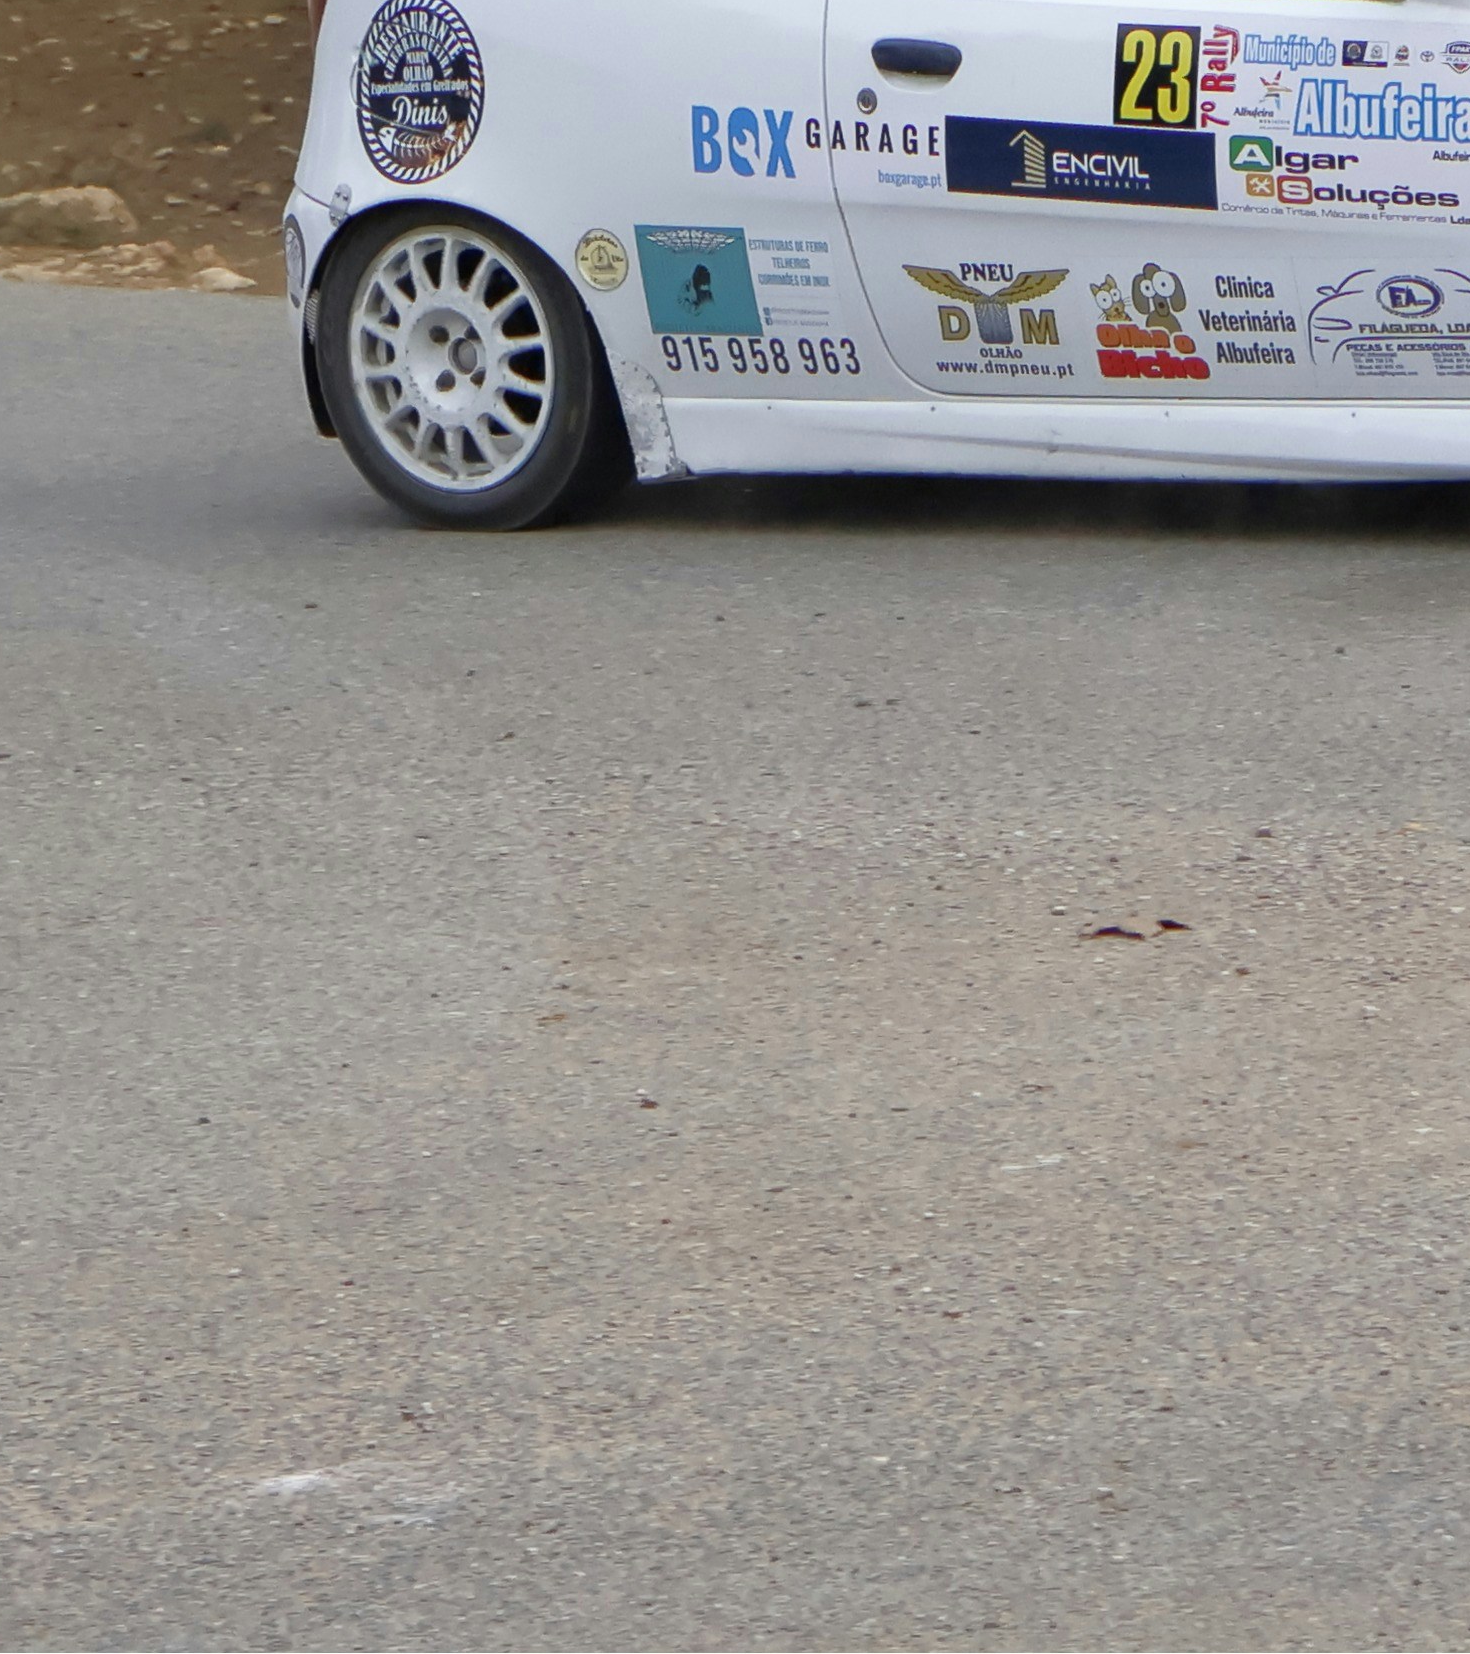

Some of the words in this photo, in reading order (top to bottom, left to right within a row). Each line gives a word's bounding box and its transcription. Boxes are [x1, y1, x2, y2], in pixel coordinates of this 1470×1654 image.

[373, 10, 462, 64] RESTAURANTE
[1243, 33, 1314, 71] Município
[1314, 37, 1336, 67] de
[402, 64, 434, 82] OLHÃO
[1200, 23, 1241, 93] Rally
[1120, 29, 1194, 124] 23
[392, 95, 448, 125] Dinis
[1233, 106, 1275, 118] Albufeira
[691, 104, 797, 179] BOX
[805, 117, 940, 156] GARAGE
[1051, 150, 1151, 179] ENCIVIL
[1232, 141, 1360, 175] Algar
[877, 169, 942, 190] boxgarage.pt
[1053, 176, 1152, 191] ENGENHARIA
[1280, 179, 1460, 210] Soluções
[959, 262, 1014, 283] PNEU
[938, 305, 971, 341] D
[1019, 308, 1060, 345] M
[1198, 309, 1297, 333] Veterinária
[979, 345, 1023, 359] OLHÃO
[1096, 323, 1171, 349] Olha
[1173, 334, 1197, 355] o
[1216, 341, 1296, 365] Albufeira
[661, 335, 720, 373] 915
[727, 337, 790, 375] 958
[797, 337, 861, 375] 963
[936, 360, 1076, 379] www.dmpneu.pt
[1096, 349, 1211, 380] Bicho
